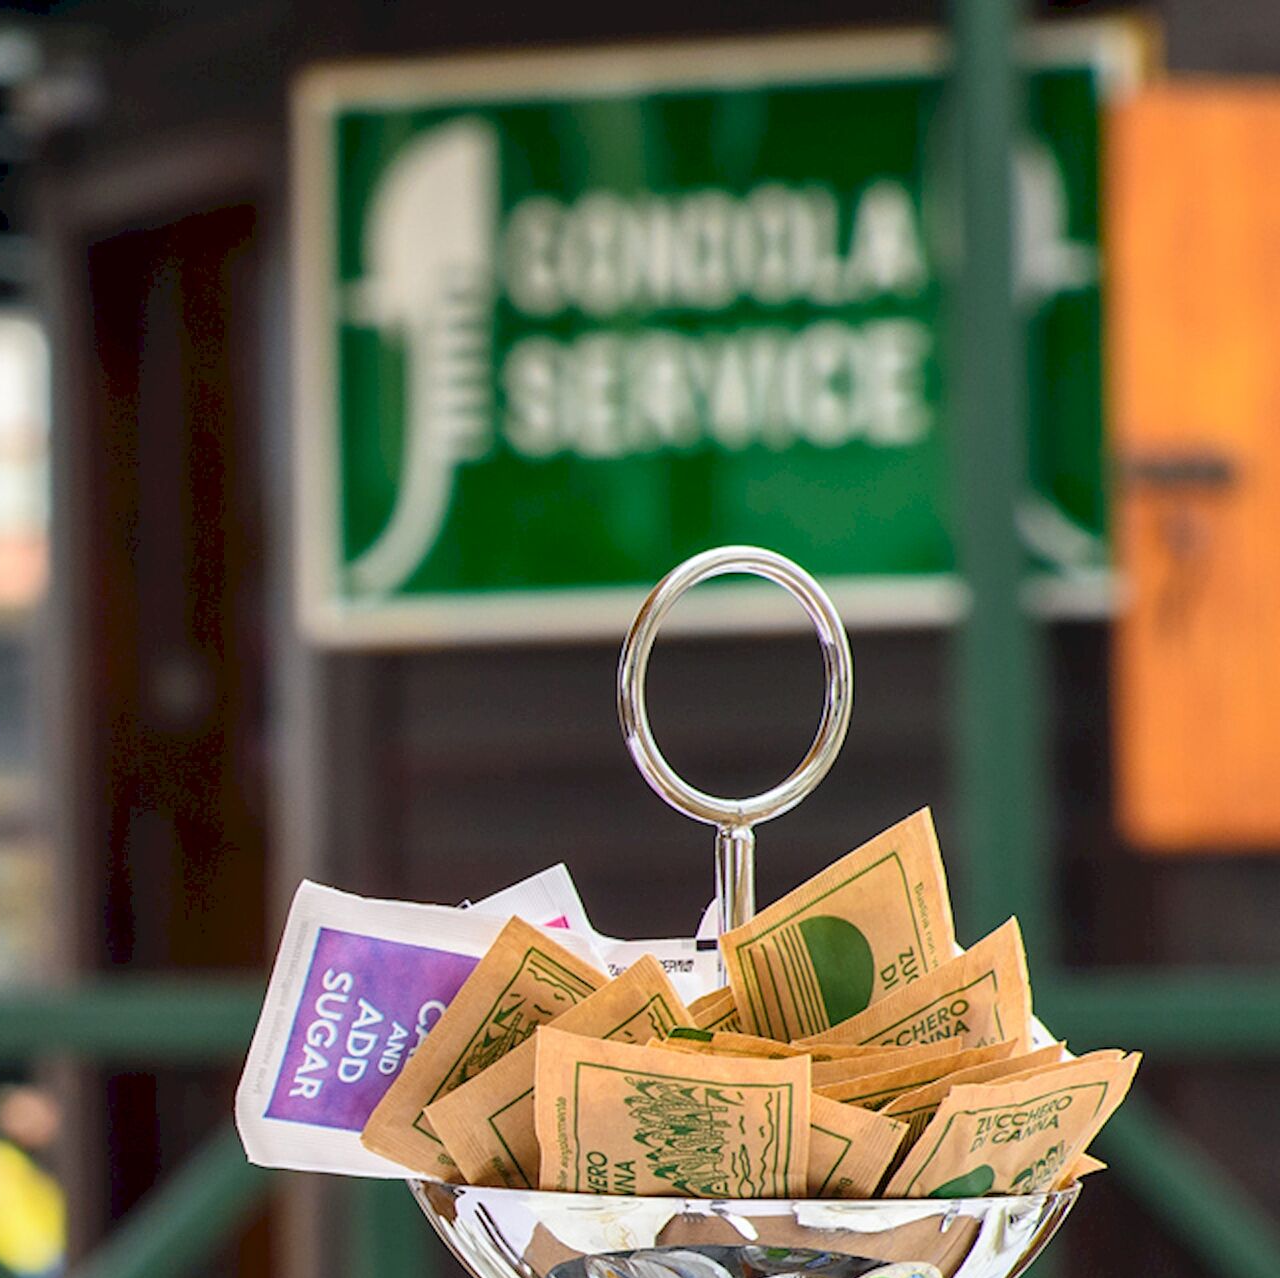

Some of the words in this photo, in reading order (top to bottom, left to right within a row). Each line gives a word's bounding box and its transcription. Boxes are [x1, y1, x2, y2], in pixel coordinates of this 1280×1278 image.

[506, 178, 925, 316] GONDOLA
[504, 318, 931, 456] SERVICE
[288, 968, 354, 1099] SUGAR
[337, 998, 384, 1083] ADD
[378, 1021, 409, 1075] AND
[976, 1095, 1072, 1136] ZUCCHERO
